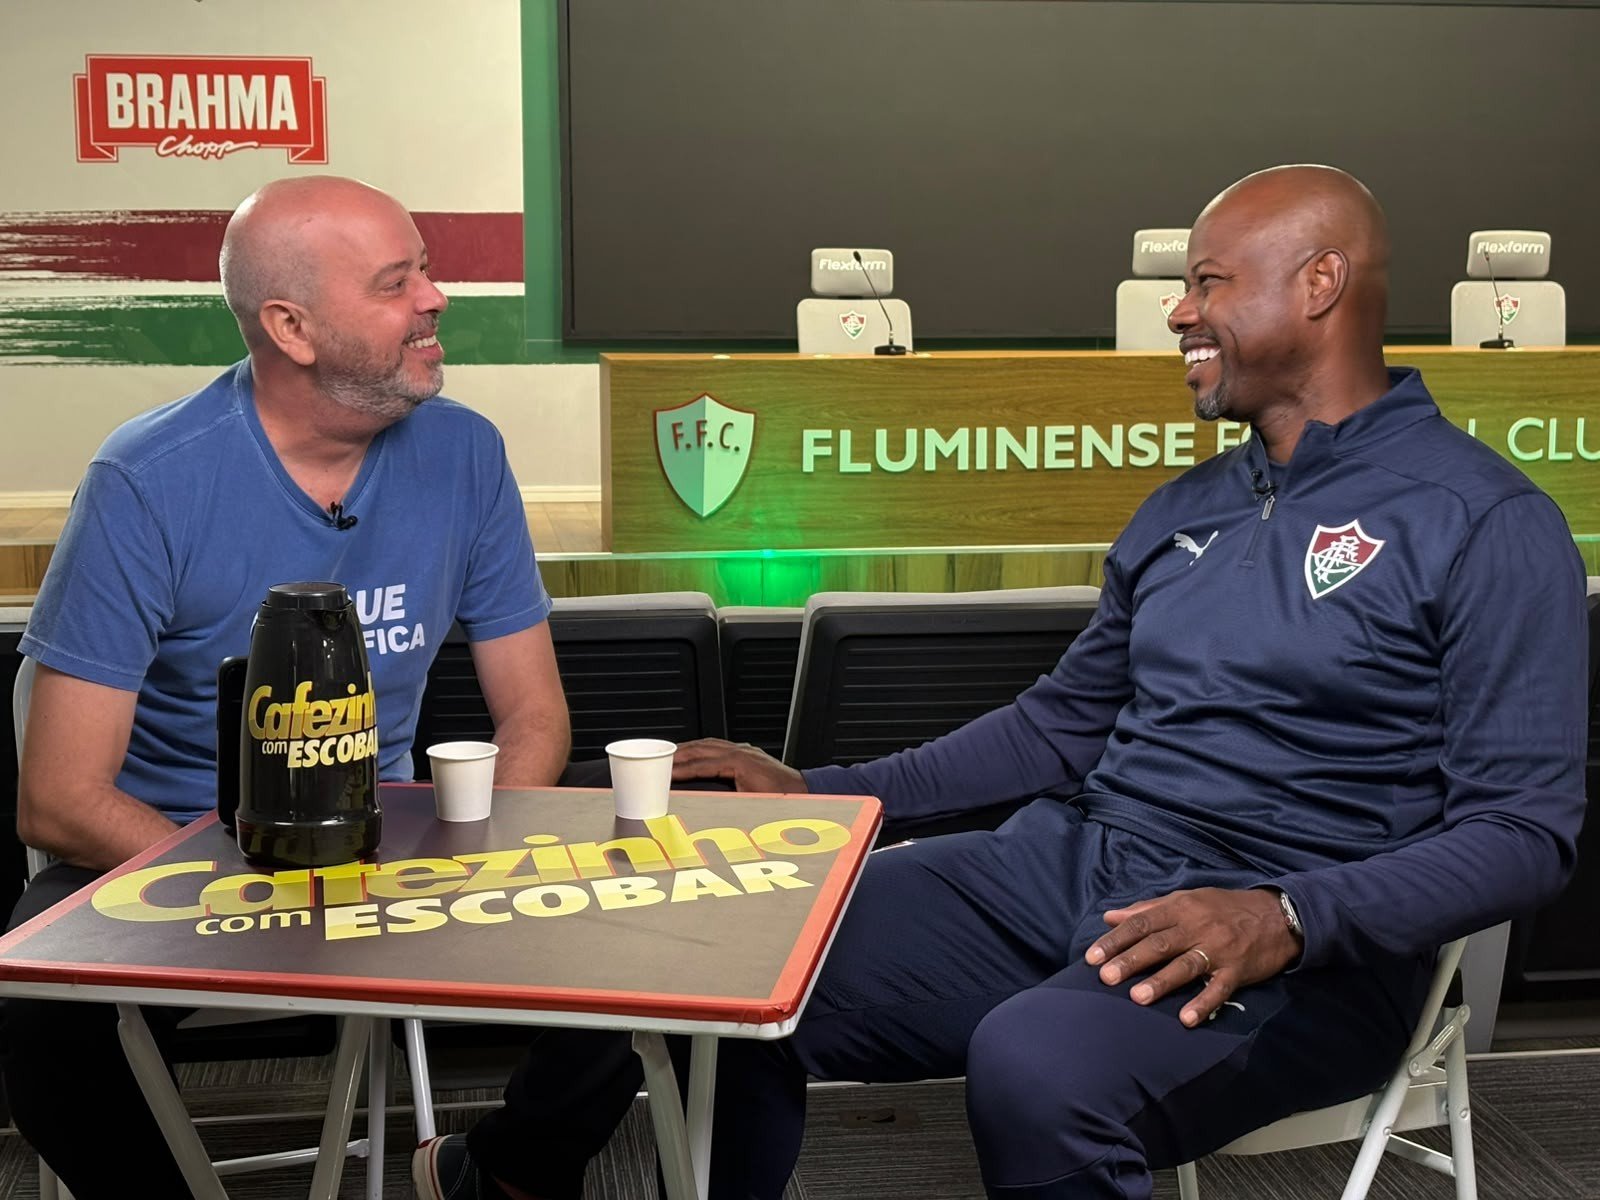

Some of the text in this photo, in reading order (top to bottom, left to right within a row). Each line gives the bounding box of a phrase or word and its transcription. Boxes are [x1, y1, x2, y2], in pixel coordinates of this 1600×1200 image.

[105, 72, 299, 131] BRAHMA
[156, 133, 259, 159] Chopp
[819, 258, 887, 271] Flexform
[1476, 241, 1545, 255] Flexform
[801, 422, 1197, 474] FLUMINENSE
[261, 727, 379, 769] com ESCOBA
[90, 813, 853, 923] Cafezinho
[194, 860, 815, 941] com ESCOBAR
